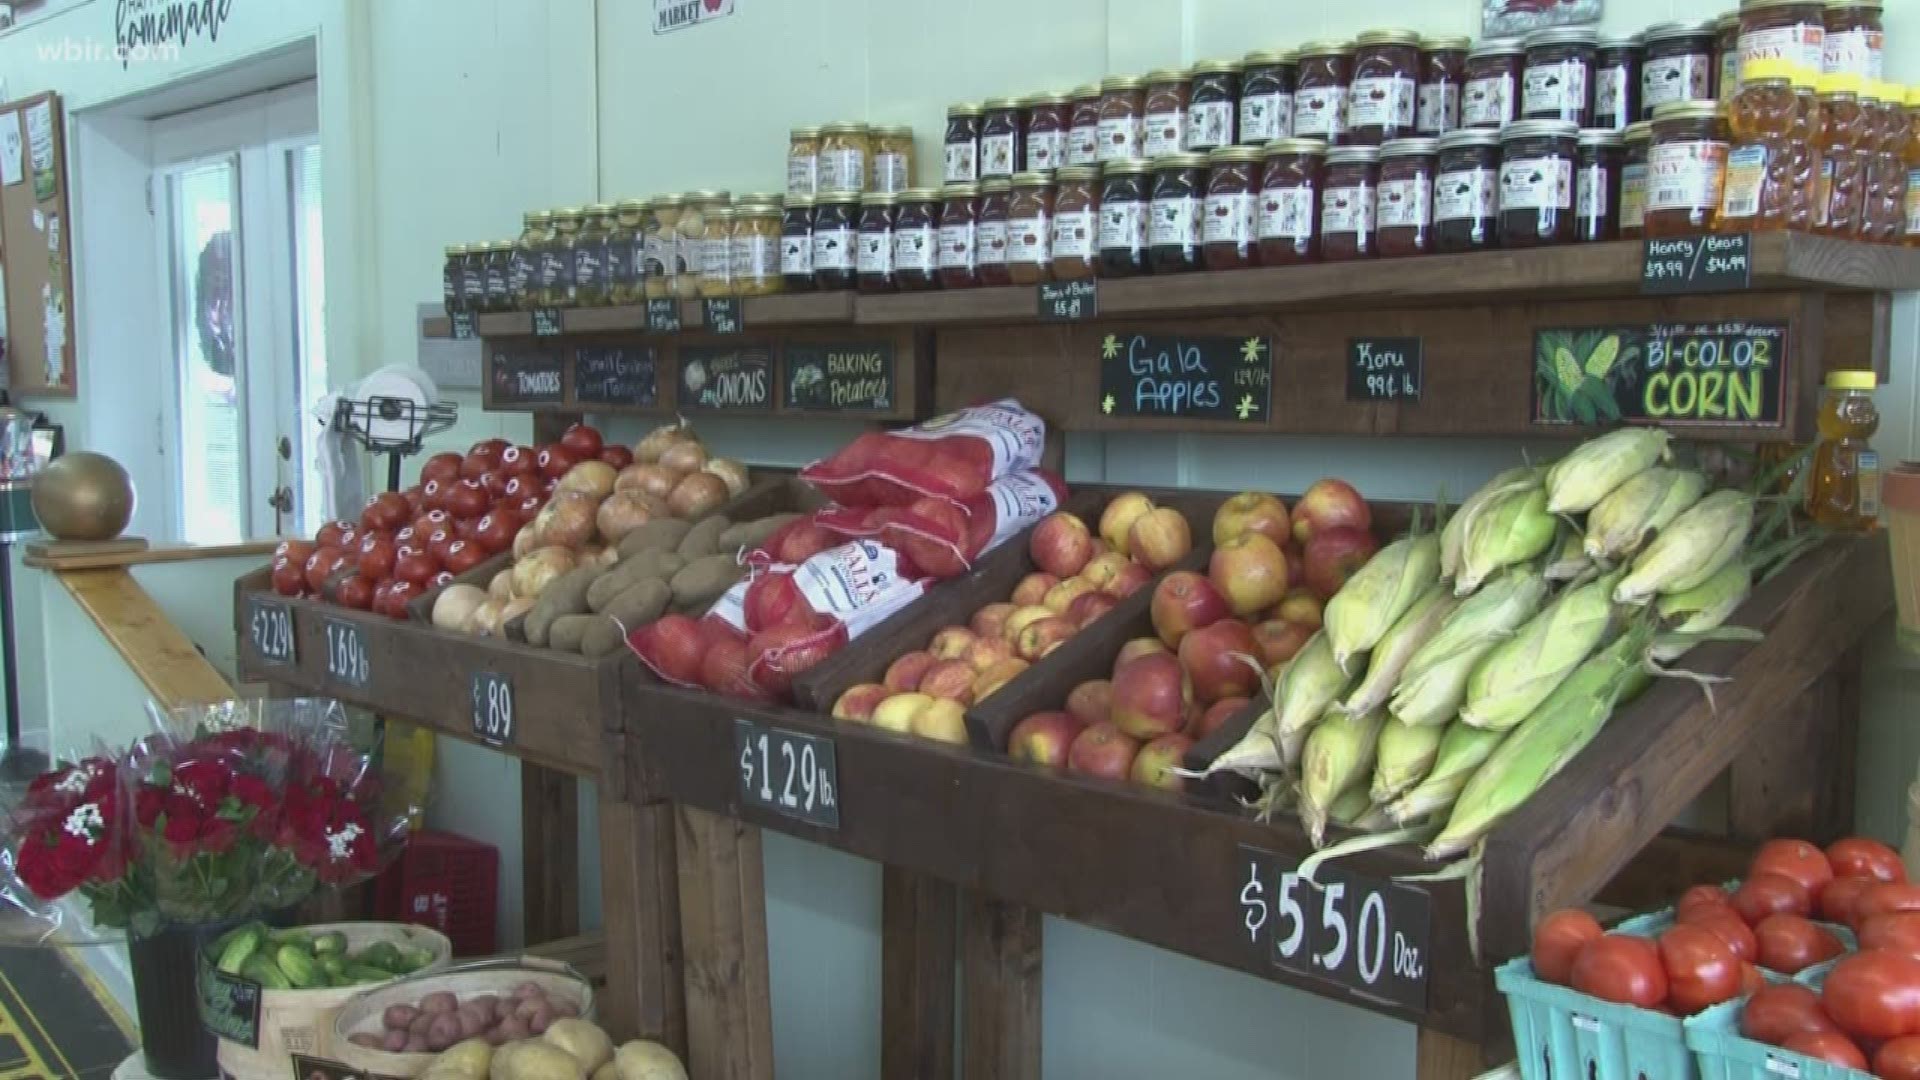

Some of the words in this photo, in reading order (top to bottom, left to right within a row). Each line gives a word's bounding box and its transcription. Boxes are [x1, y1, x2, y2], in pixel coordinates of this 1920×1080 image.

[658, 1, 700, 28] MARKET
[1649, 240, 1693, 258] Honey
[1707, 235, 1743, 251] Bears
[1706, 254, 1746, 274] $4.99
[828, 353, 882, 374] BAKING
[1129, 335, 1208, 375] Gala
[1357, 342, 1405, 371] Koru
[1647, 338, 1770, 367] BI-COLOR
[717, 368, 766, 405] ONIONS
[1136, 377, 1220, 414] Apples
[1645, 370, 1763, 420] CORN
[741, 733, 817, 813] $1.29
[818, 767, 835, 807] lb.
[1240, 861, 1387, 984] $5.50
[1393, 931, 1424, 978] Doz.
